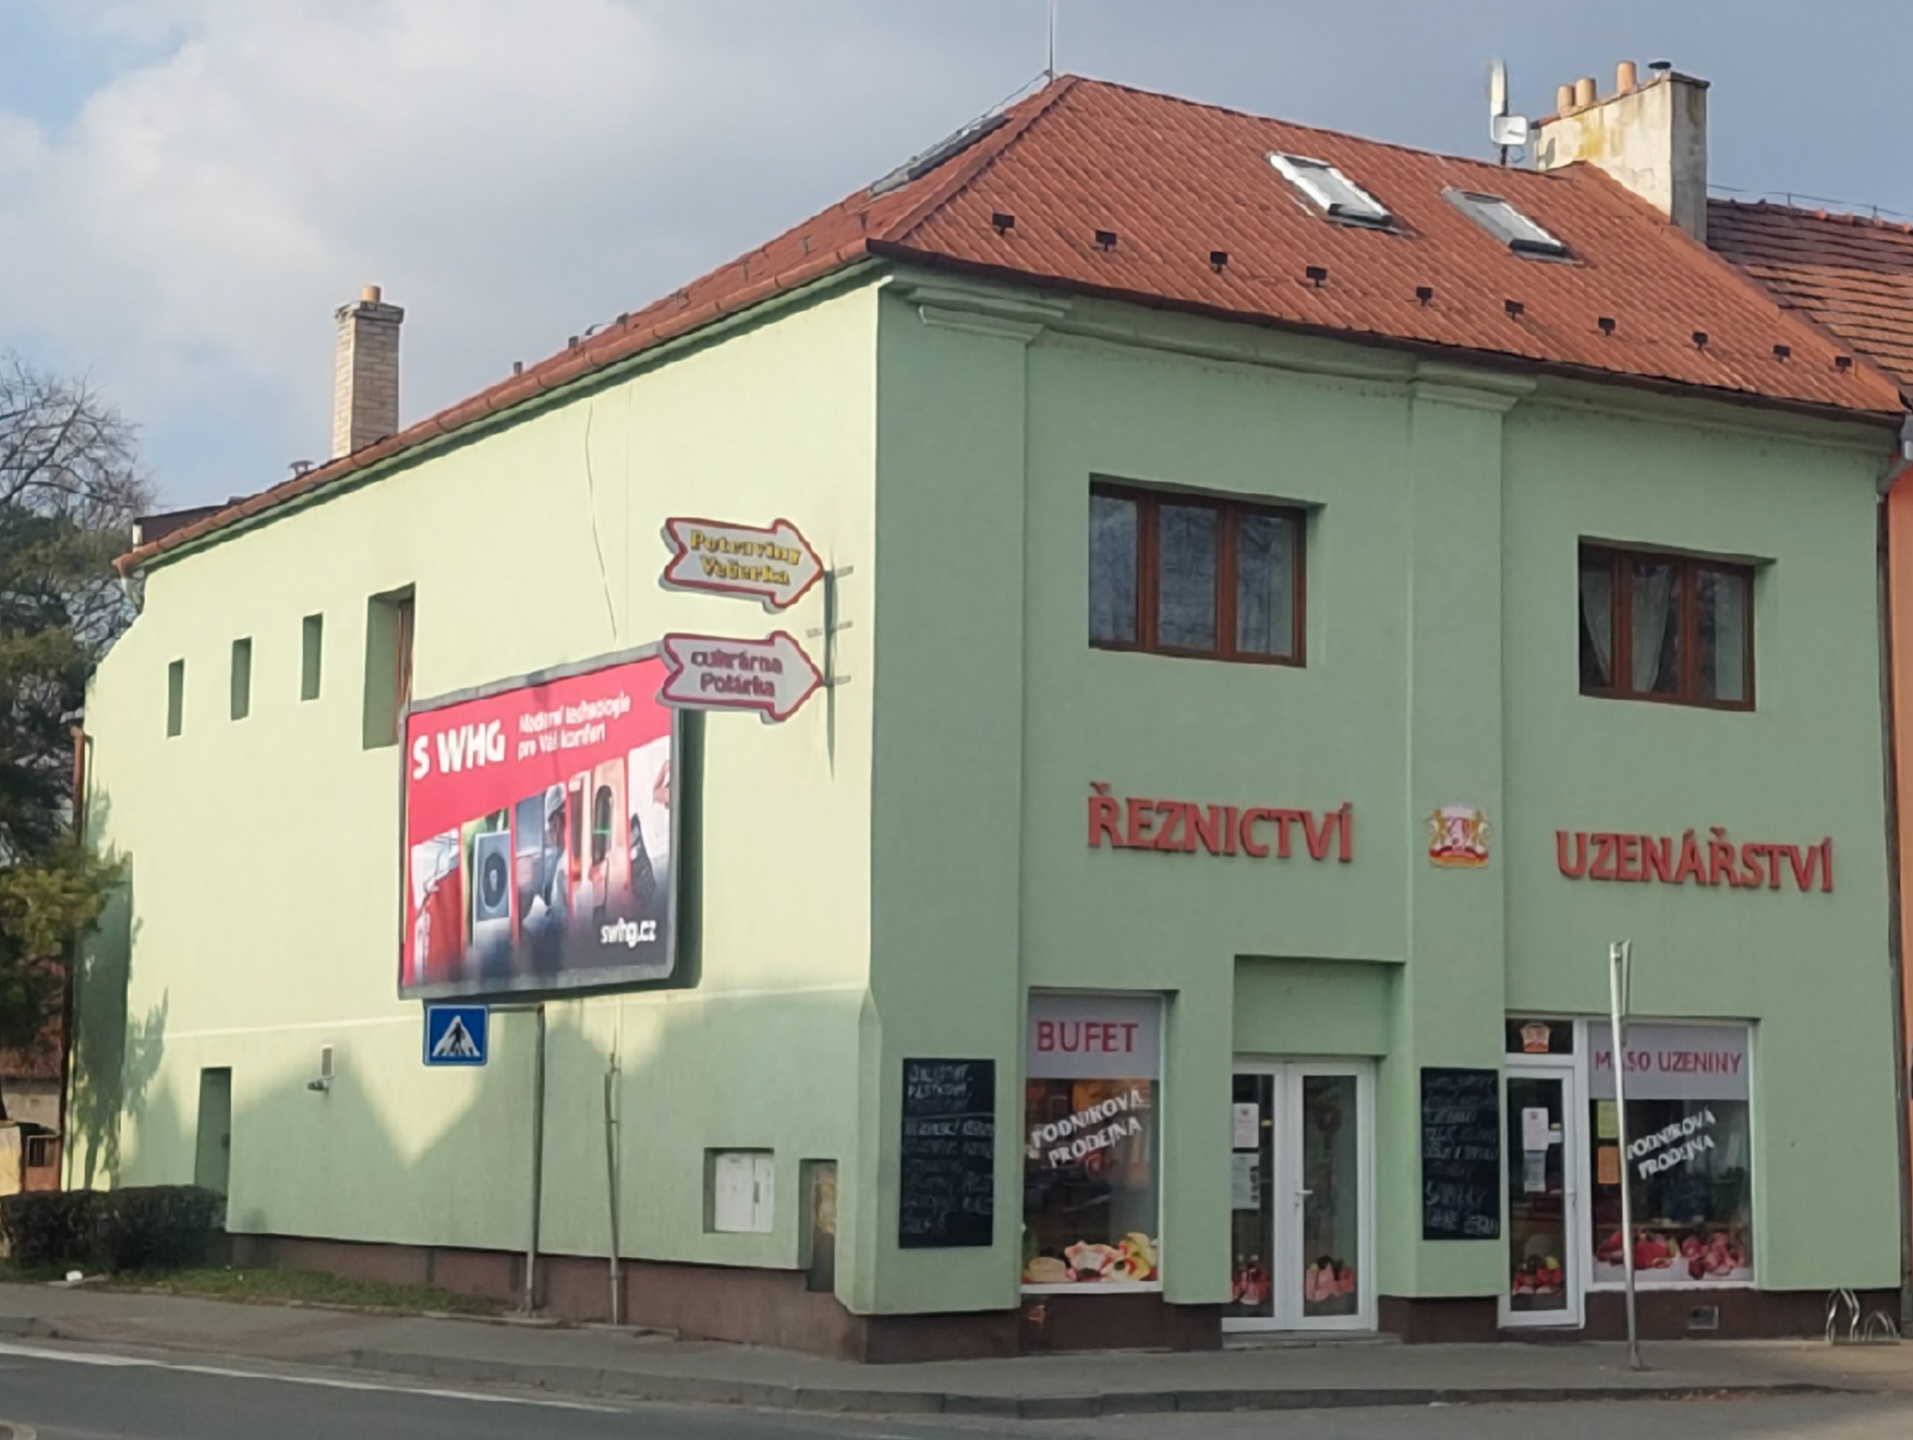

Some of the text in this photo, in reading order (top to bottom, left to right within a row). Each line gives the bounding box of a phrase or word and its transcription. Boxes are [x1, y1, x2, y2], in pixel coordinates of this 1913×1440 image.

[691, 650, 782, 673] cukrárna
[700, 671, 775, 697] Polárka
[412, 720, 505, 779] S WHG
[1087, 782, 1353, 862] ŘEZNICTVÍ
[1555, 827, 1833, 893] UZENÁŘSTVÍ
[601, 916, 657, 948] swhg.cz
[1037, 1021, 1139, 1052] BUFET
[1595, 1051, 1742, 1074] MSO UZENINY
[1048, 1116, 1142, 1169] PRODEJNA
